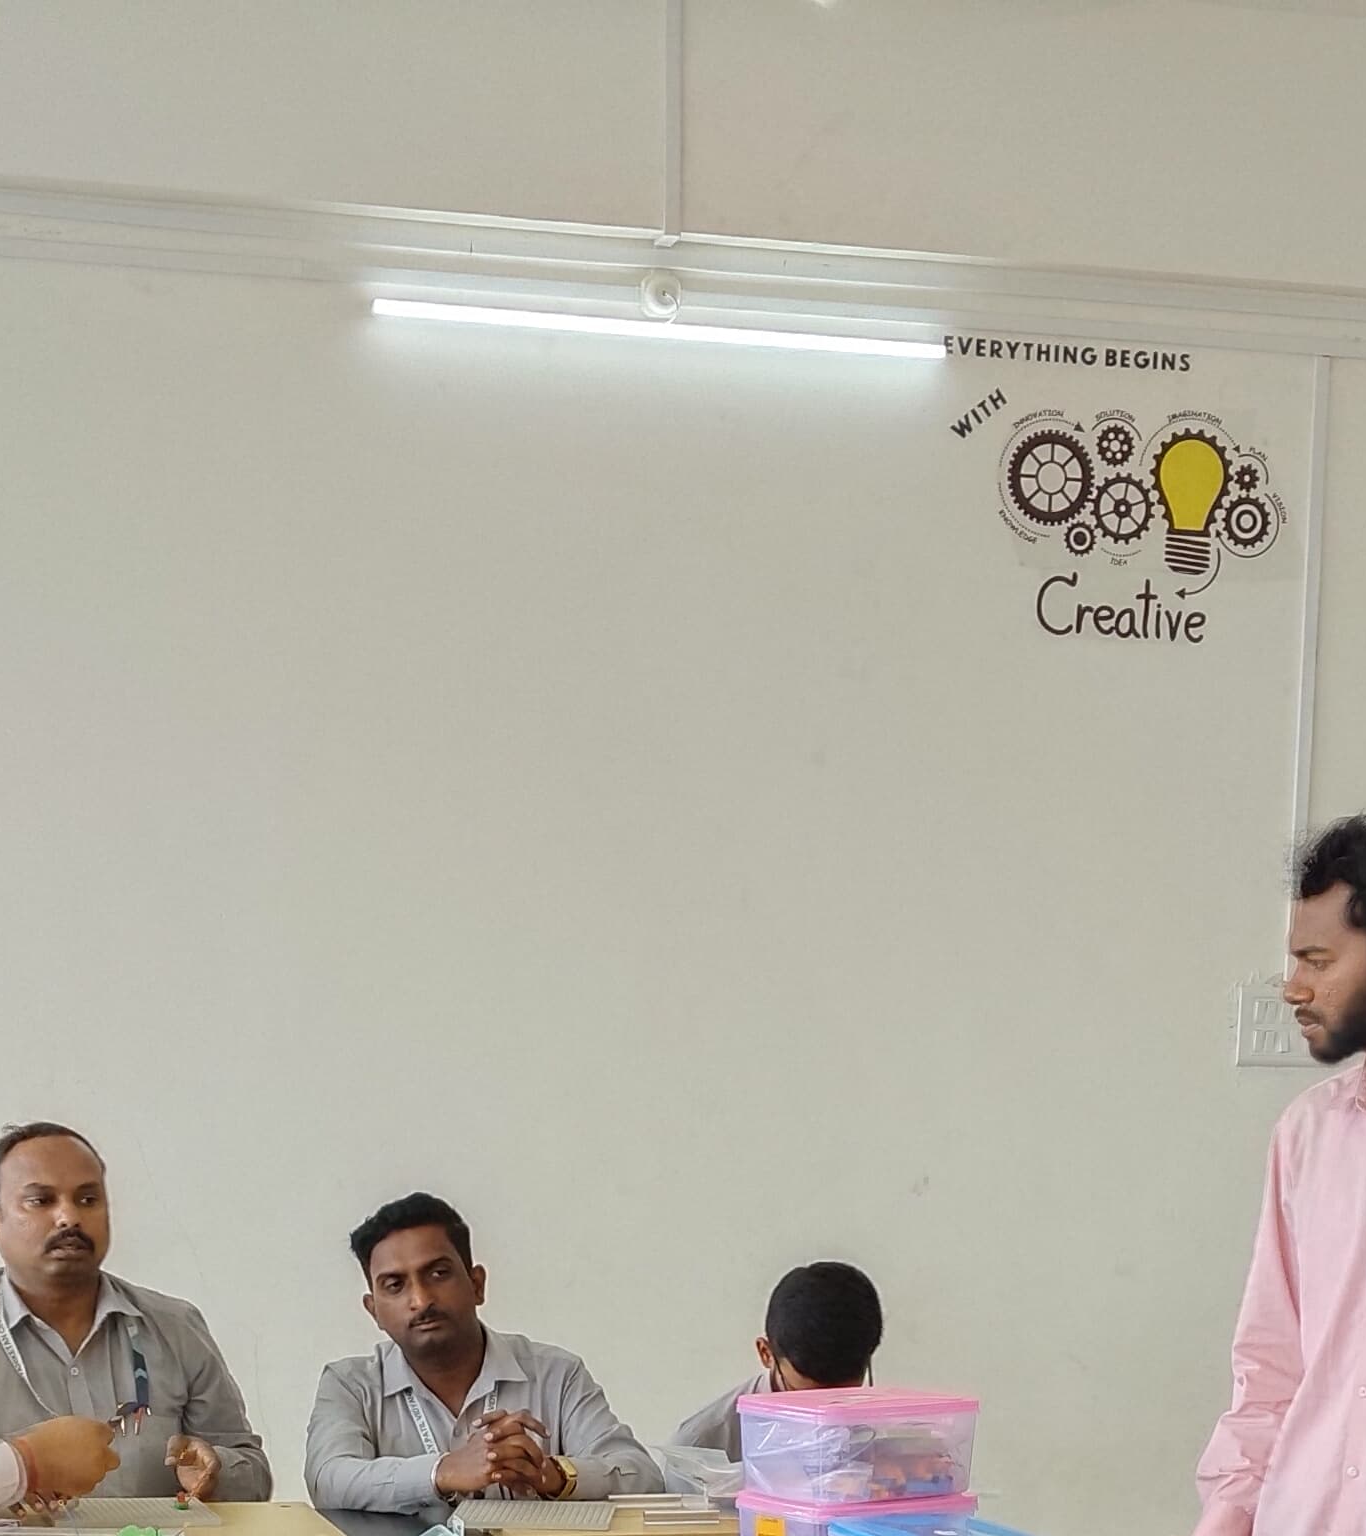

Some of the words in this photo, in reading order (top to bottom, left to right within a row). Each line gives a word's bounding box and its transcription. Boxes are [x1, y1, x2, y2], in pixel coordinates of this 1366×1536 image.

[943, 335, 1098, 366] EVERYTHING
[1104, 348, 1191, 372] BEGINS
[950, 387, 1008, 439] WITH
[1095, 409, 1136, 423] SOLUTION
[1167, 410, 1223, 425] IMAGINATION
[1249, 446, 1269, 463] PLAN
[1271, 492, 1287, 524] VISION
[1109, 558, 1128, 567] IDEA
[1036, 571, 1207, 644] Creative
